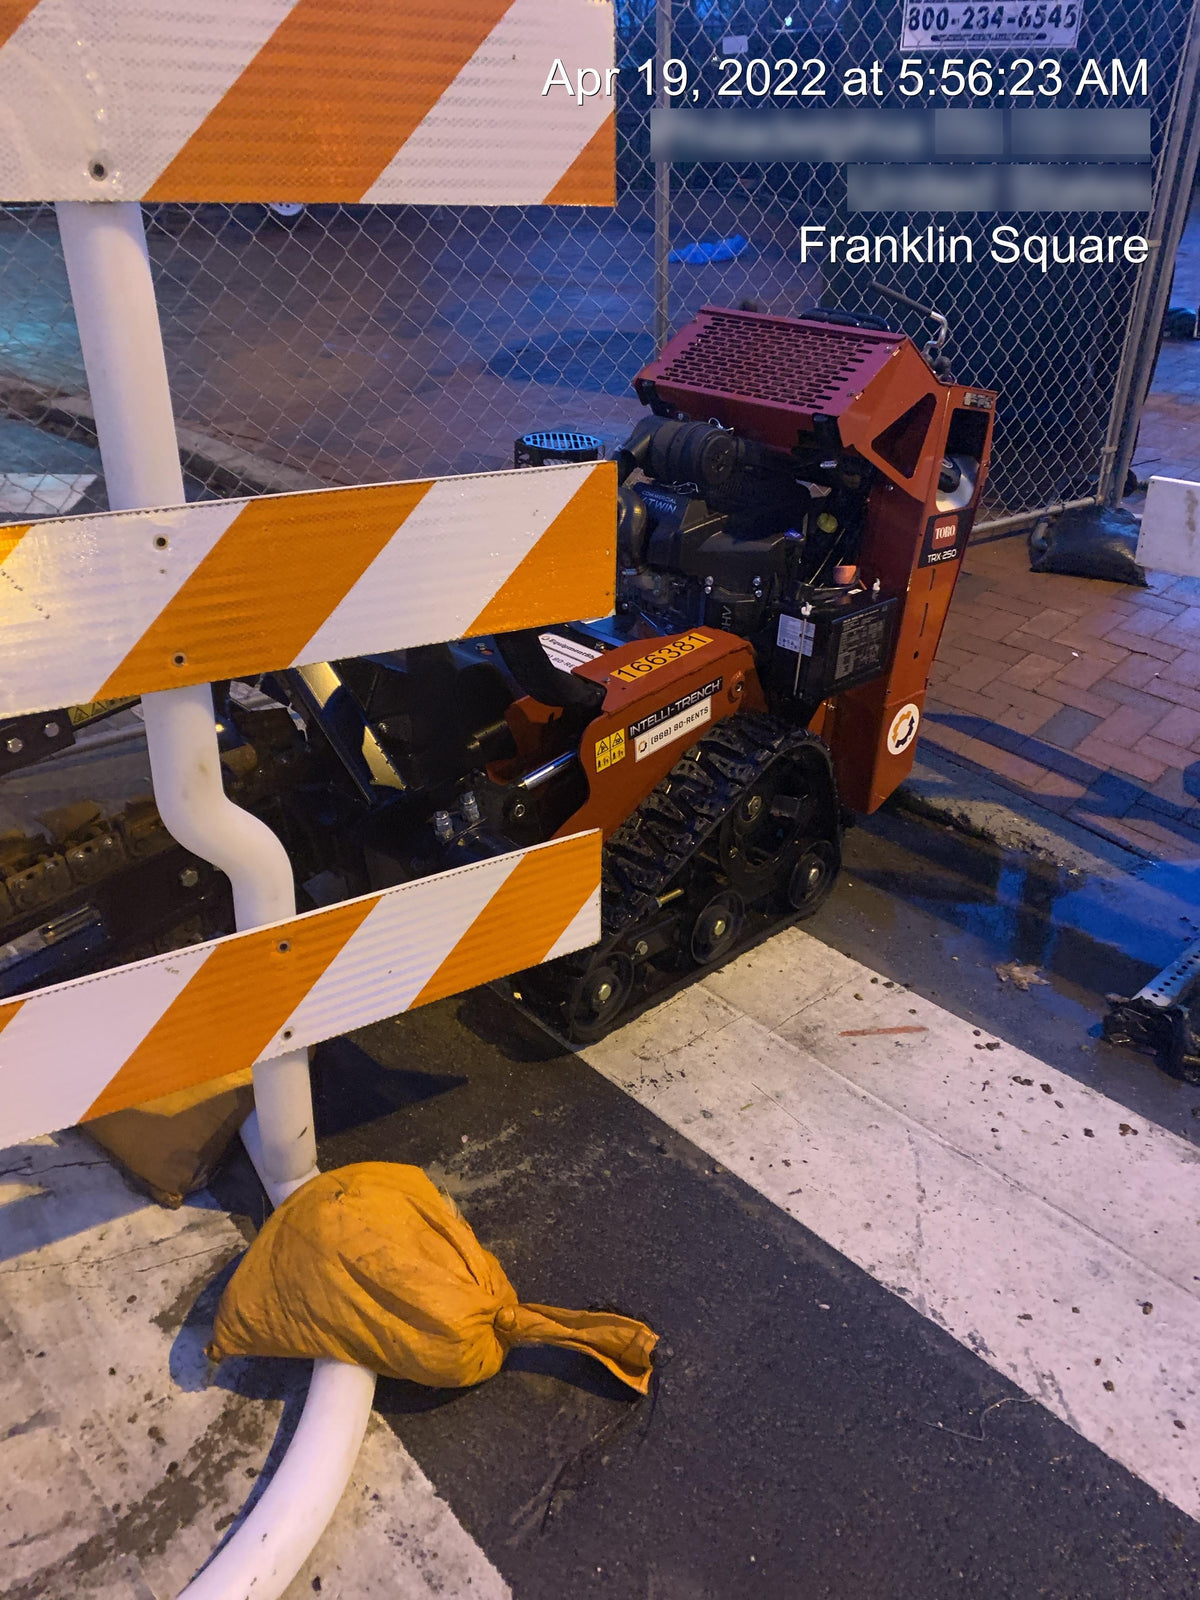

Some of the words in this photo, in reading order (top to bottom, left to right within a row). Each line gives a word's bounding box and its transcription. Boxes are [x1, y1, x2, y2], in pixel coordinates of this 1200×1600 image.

[907, 4, 1078, 31] 800-234-6545
[935, 525, 956, 540] TORO
[617, 635, 707, 679] 166381
[630, 679, 722, 737] INTELLI-TRENCH
[651, 727, 672, 745] (888)
